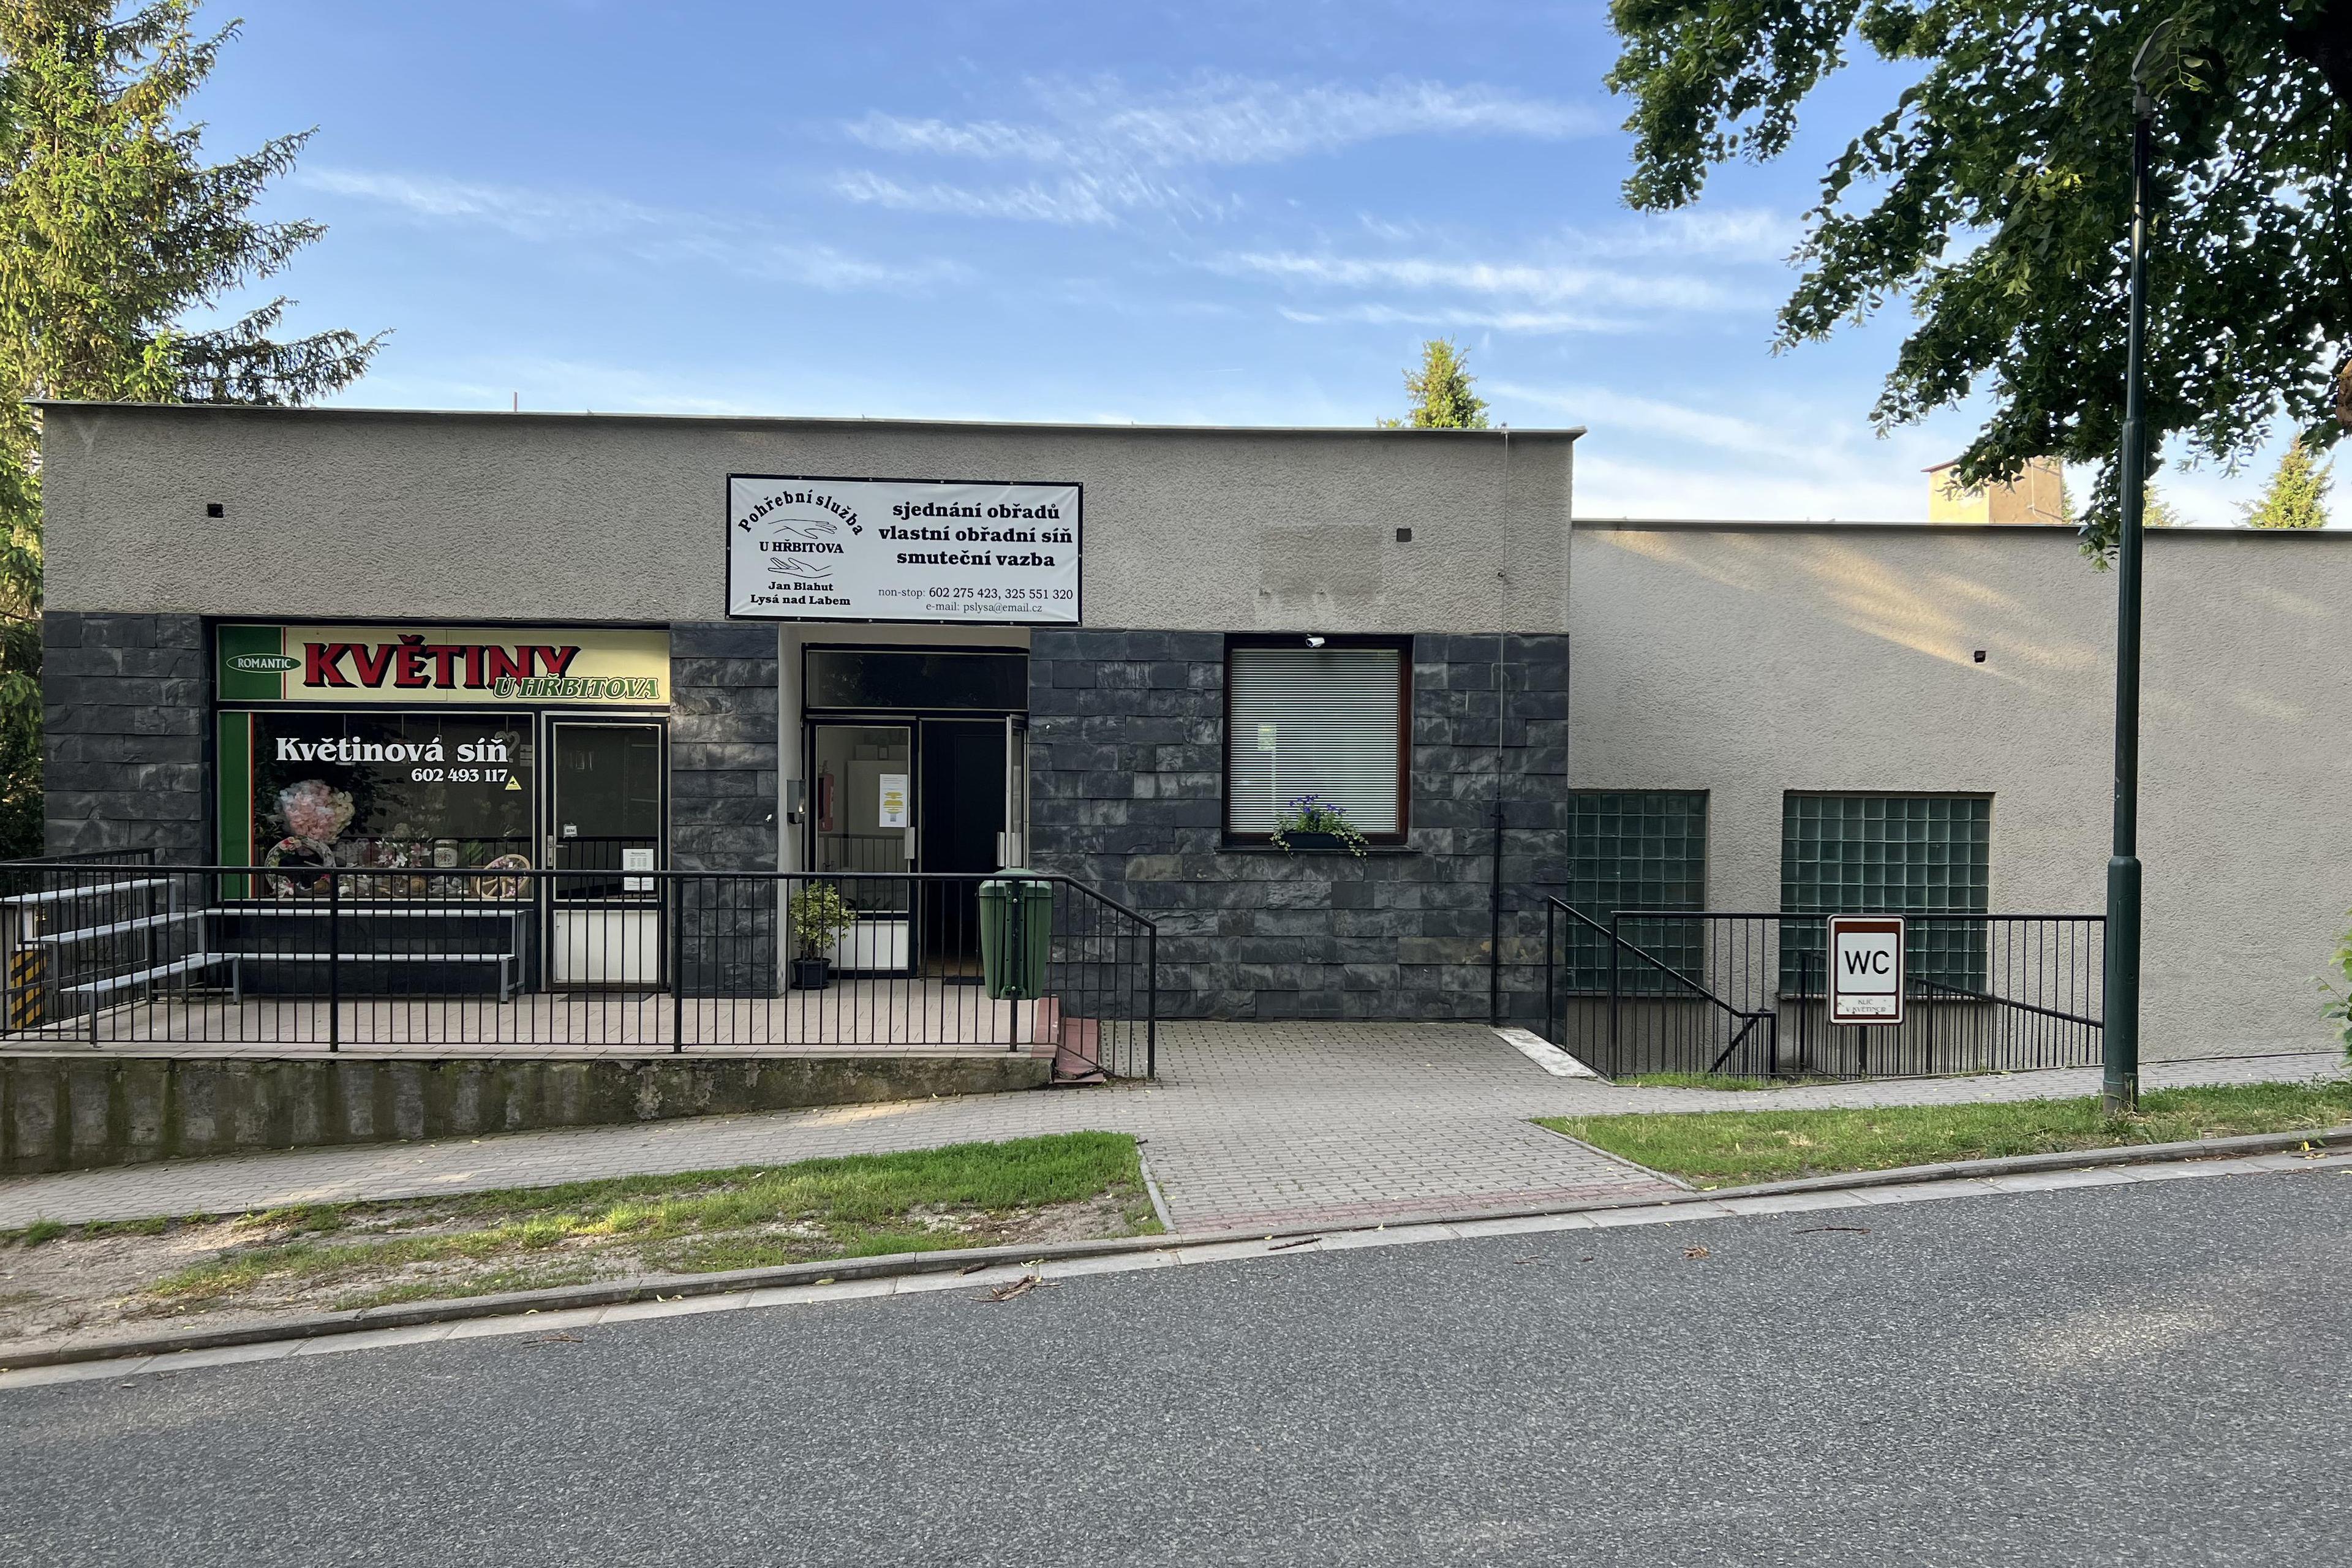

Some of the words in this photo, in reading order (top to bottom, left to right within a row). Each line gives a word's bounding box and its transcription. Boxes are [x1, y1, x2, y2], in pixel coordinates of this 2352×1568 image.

[738, 489, 813, 533] Pohřební
[816, 495, 863, 535] služba
[893, 501, 982, 520] sjednání
[987, 503, 1060, 519] obřadů
[878, 526, 950, 541] vlastní
[956, 526, 1036, 543] obřadní
[1041, 527, 1073, 543] síň
[760, 541, 769, 551] U
[772, 539, 844, 553] HŘBITOVA
[897, 550, 992, 566] smuteční
[996, 552, 1055, 567] vazba
[768, 581, 791, 590] Jan
[794, 582, 834, 591] Blahut
[878, 588, 926, 600] non-stop:
[929, 587, 949, 598] 602
[953, 588, 974, 598] 275
[977, 588, 1001, 600] 423,
[1005, 589, 1025, 599] 325
[1029, 589, 1049, 600] 551
[1052, 589, 1073, 600] 320
[750, 594, 779, 605] Lysá
[782, 595, 806, 605] nad
[809, 595, 851, 605] Labem
[925, 603, 960, 612] e-mail:
[963, 603, 1042, 613] pslysa@email.cz
[238, 658, 292, 669] ROMANTIC
[303, 634, 581, 690] KVĚTINY
[494, 677, 516, 699] U
[517, 673, 660, 699] HŘBITOVA
[276, 736, 445, 763] Květinová
[457, 737, 508, 763] síň
[411, 768, 444, 782] 602
[447, 768, 480, 782] 493
[484, 769, 508, 782] 117
[1844, 950, 1890, 974] WC
